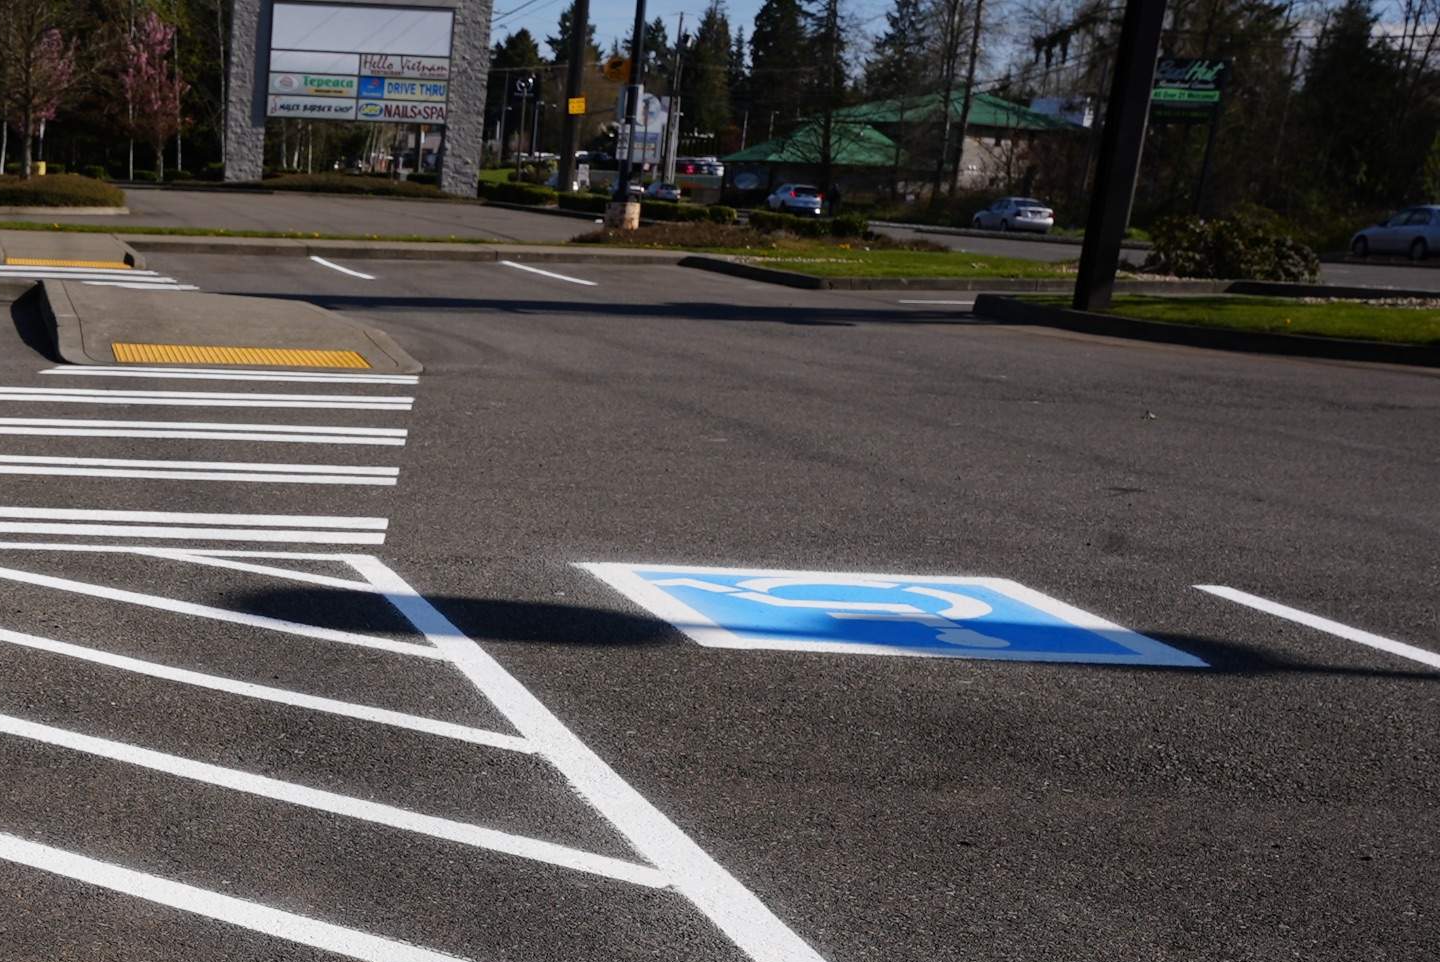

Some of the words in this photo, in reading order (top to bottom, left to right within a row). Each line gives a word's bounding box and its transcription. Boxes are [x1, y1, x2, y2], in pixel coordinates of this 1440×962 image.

[363, 55, 394, 70] Hello
[400, 56, 447, 74] Vietnam
[303, 76, 354, 88] Tepeaca
[387, 82, 416, 95] DRIVE
[419, 84, 446, 97] THRU
